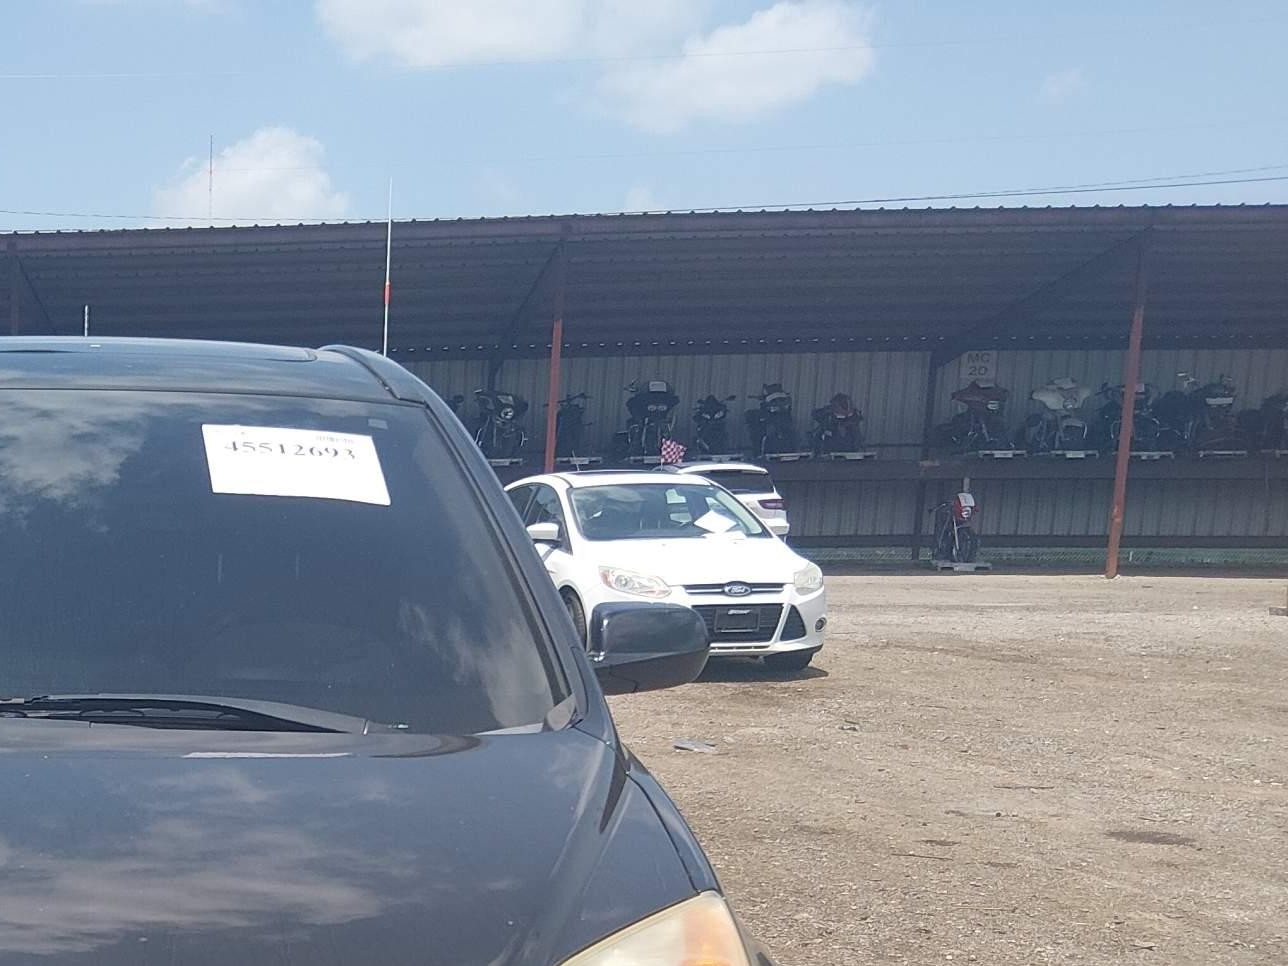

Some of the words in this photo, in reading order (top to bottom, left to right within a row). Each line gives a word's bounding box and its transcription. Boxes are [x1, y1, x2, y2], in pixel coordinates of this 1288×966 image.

[968, 352, 990, 363] MC
[968, 366, 988, 376] 20
[224, 440, 357, 460] 45512693
